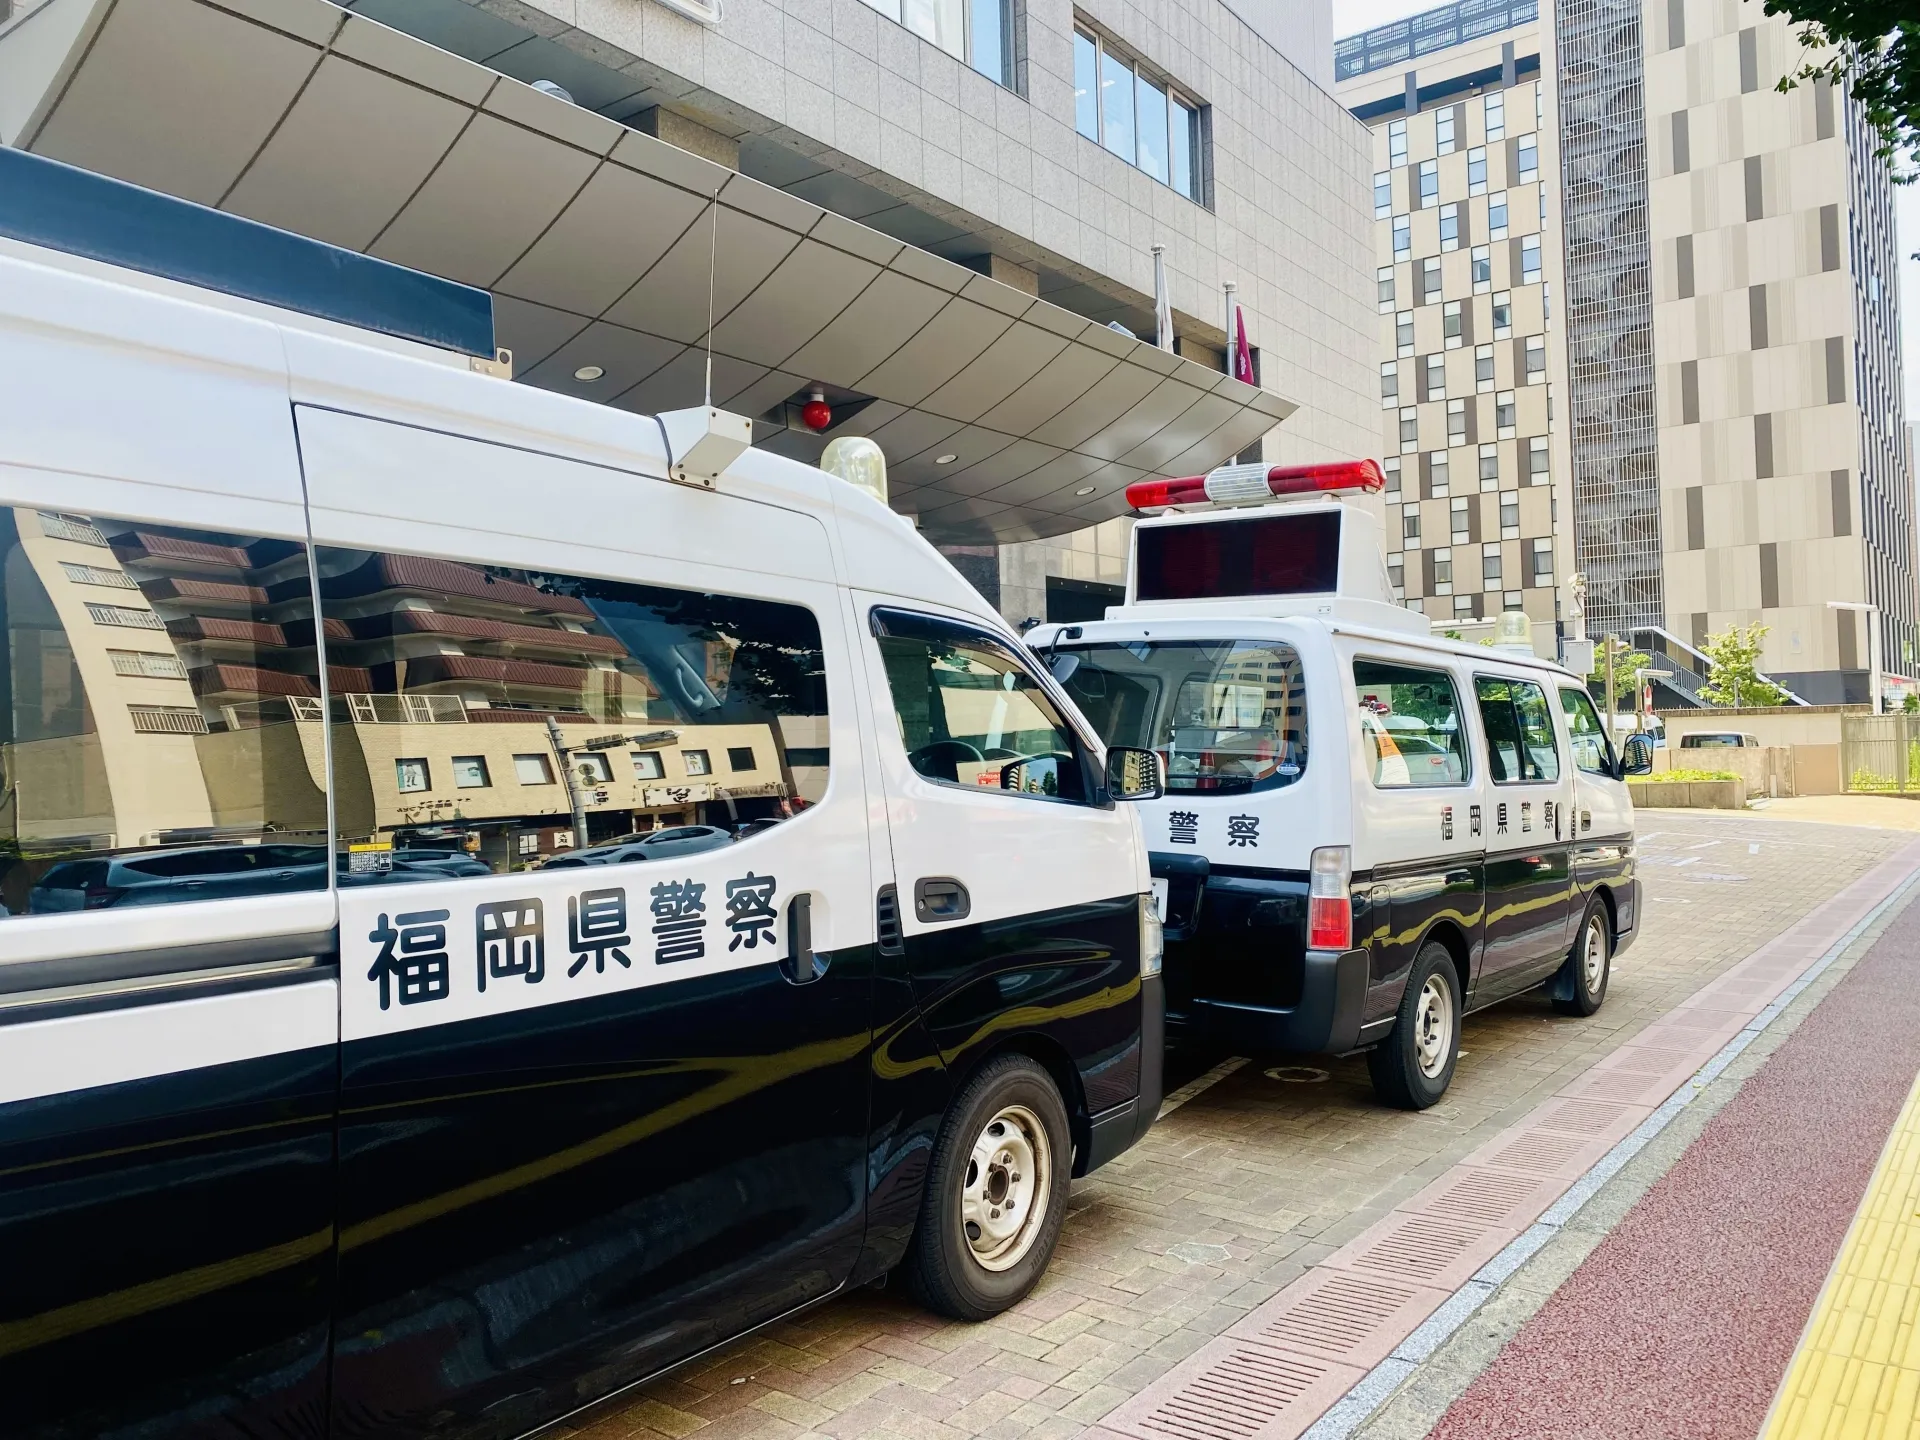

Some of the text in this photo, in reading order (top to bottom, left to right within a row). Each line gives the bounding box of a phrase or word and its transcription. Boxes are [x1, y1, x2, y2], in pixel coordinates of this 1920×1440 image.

[1169, 810, 1260, 848] 警察
[368, 870, 778, 1011] 福岡県警察
